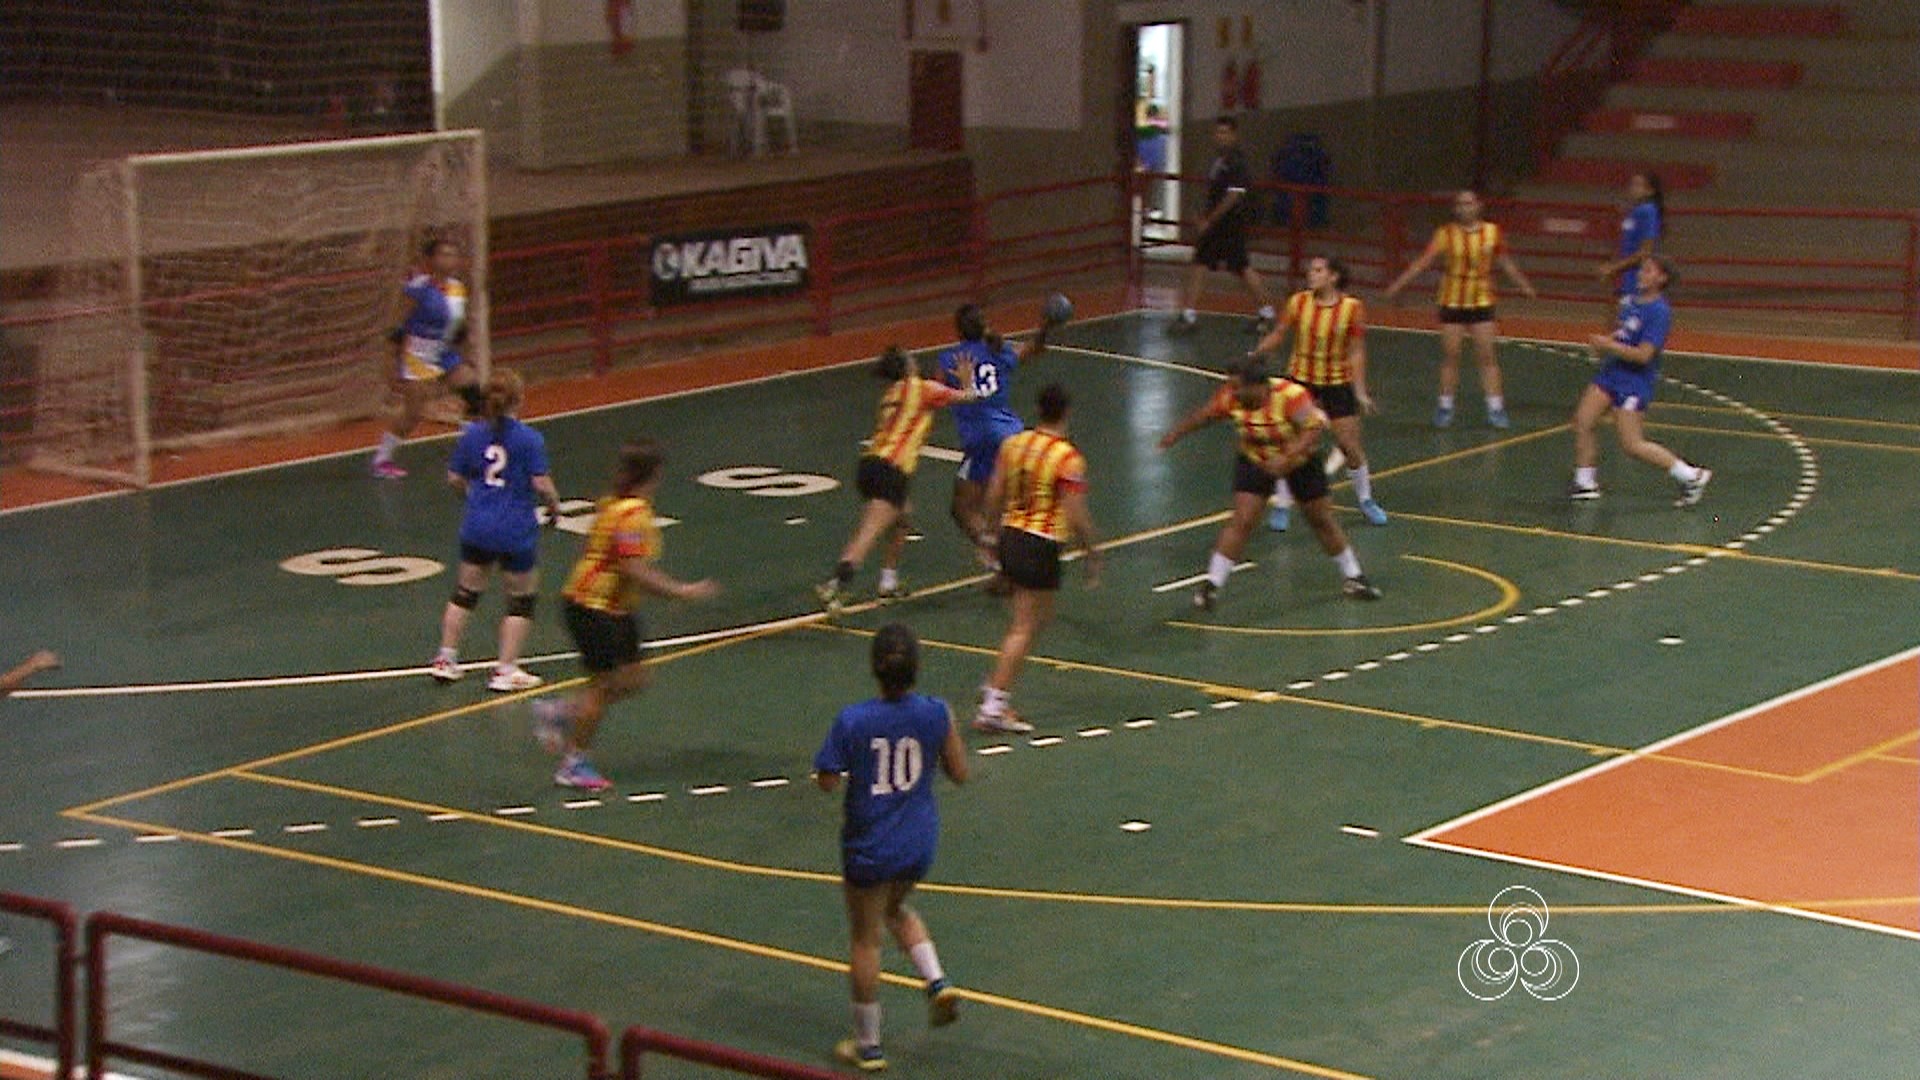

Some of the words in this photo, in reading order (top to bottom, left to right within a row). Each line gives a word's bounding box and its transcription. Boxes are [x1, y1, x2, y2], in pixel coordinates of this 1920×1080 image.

[681, 234, 808, 279] KAGIVA
[484, 444, 507, 487] 2
[869, 736, 923, 795] 10
